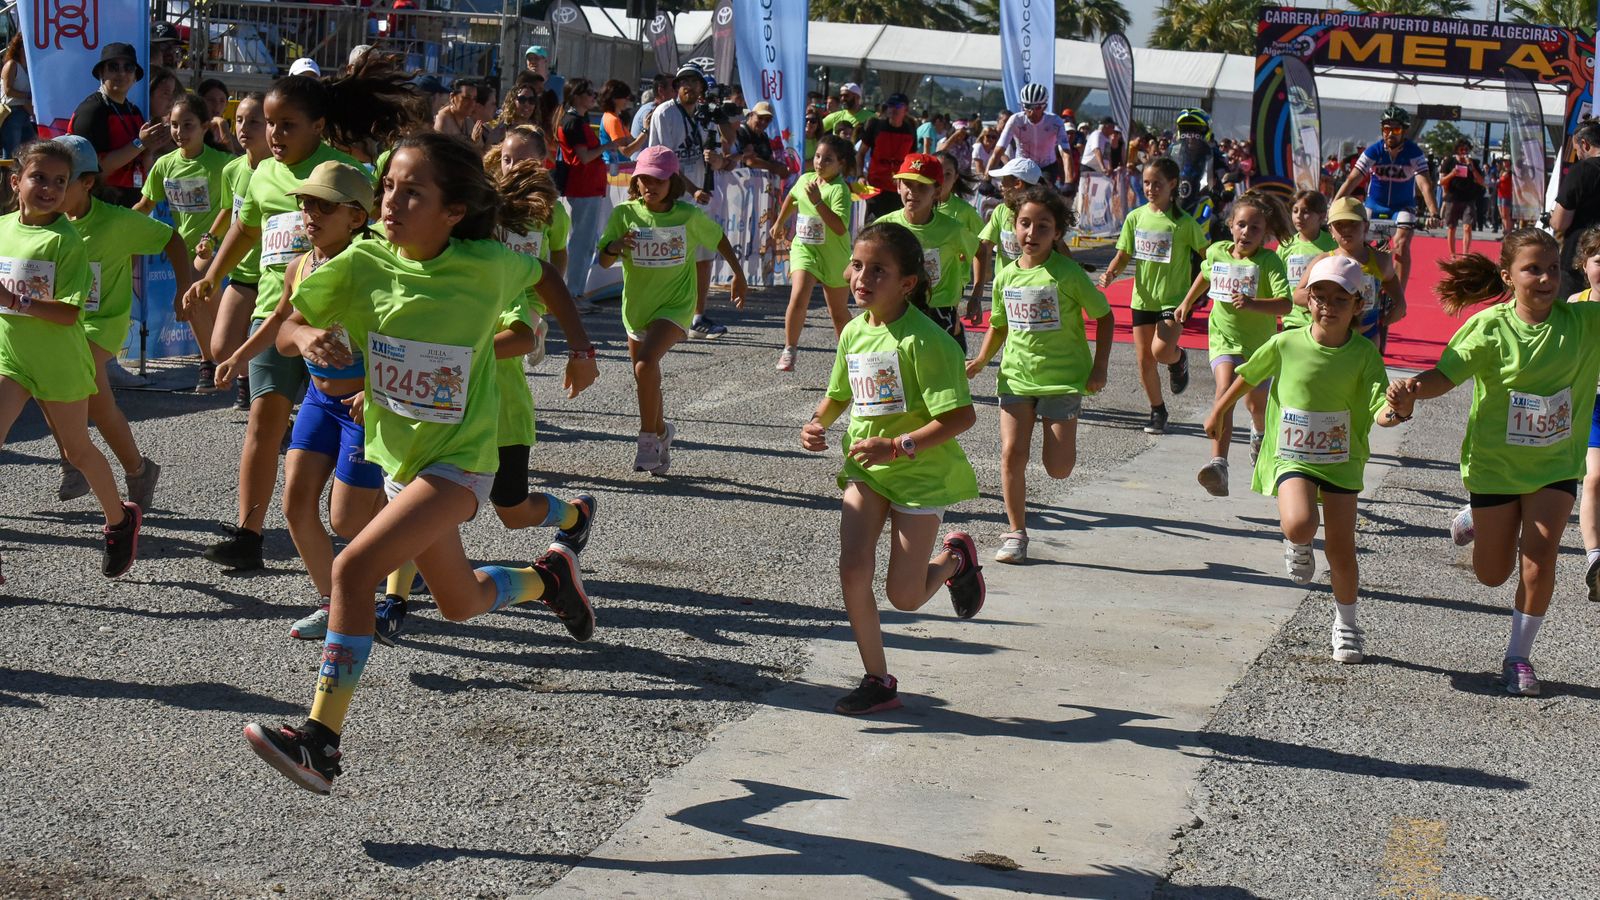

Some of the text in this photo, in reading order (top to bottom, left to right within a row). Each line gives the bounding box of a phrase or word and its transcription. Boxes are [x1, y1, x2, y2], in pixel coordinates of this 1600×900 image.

[1265, 10, 1558, 42] CARRERA POPULAR PUERTO BAHÍA DE ALGECIRAS
[1328, 30, 1556, 76] META
[1375, 166, 1408, 178] UCA
[168, 190, 192, 204] 1411
[264, 230, 291, 252] 1400
[1136, 239, 1157, 253] 1397
[635, 242, 669, 257] 1126
[1213, 276, 1239, 292] 1449
[1007, 302, 1038, 319] 1455
[158, 325, 194, 346] Algecira
[372, 338, 387, 354] XXI
[427, 349, 447, 357] JULIA
[374, 361, 433, 399] 1245
[1512, 396, 1526, 406] XXI
[1283, 412, 1296, 422] XXI
[1513, 412, 1555, 433] 1155
[1284, 427, 1327, 449] 1242
